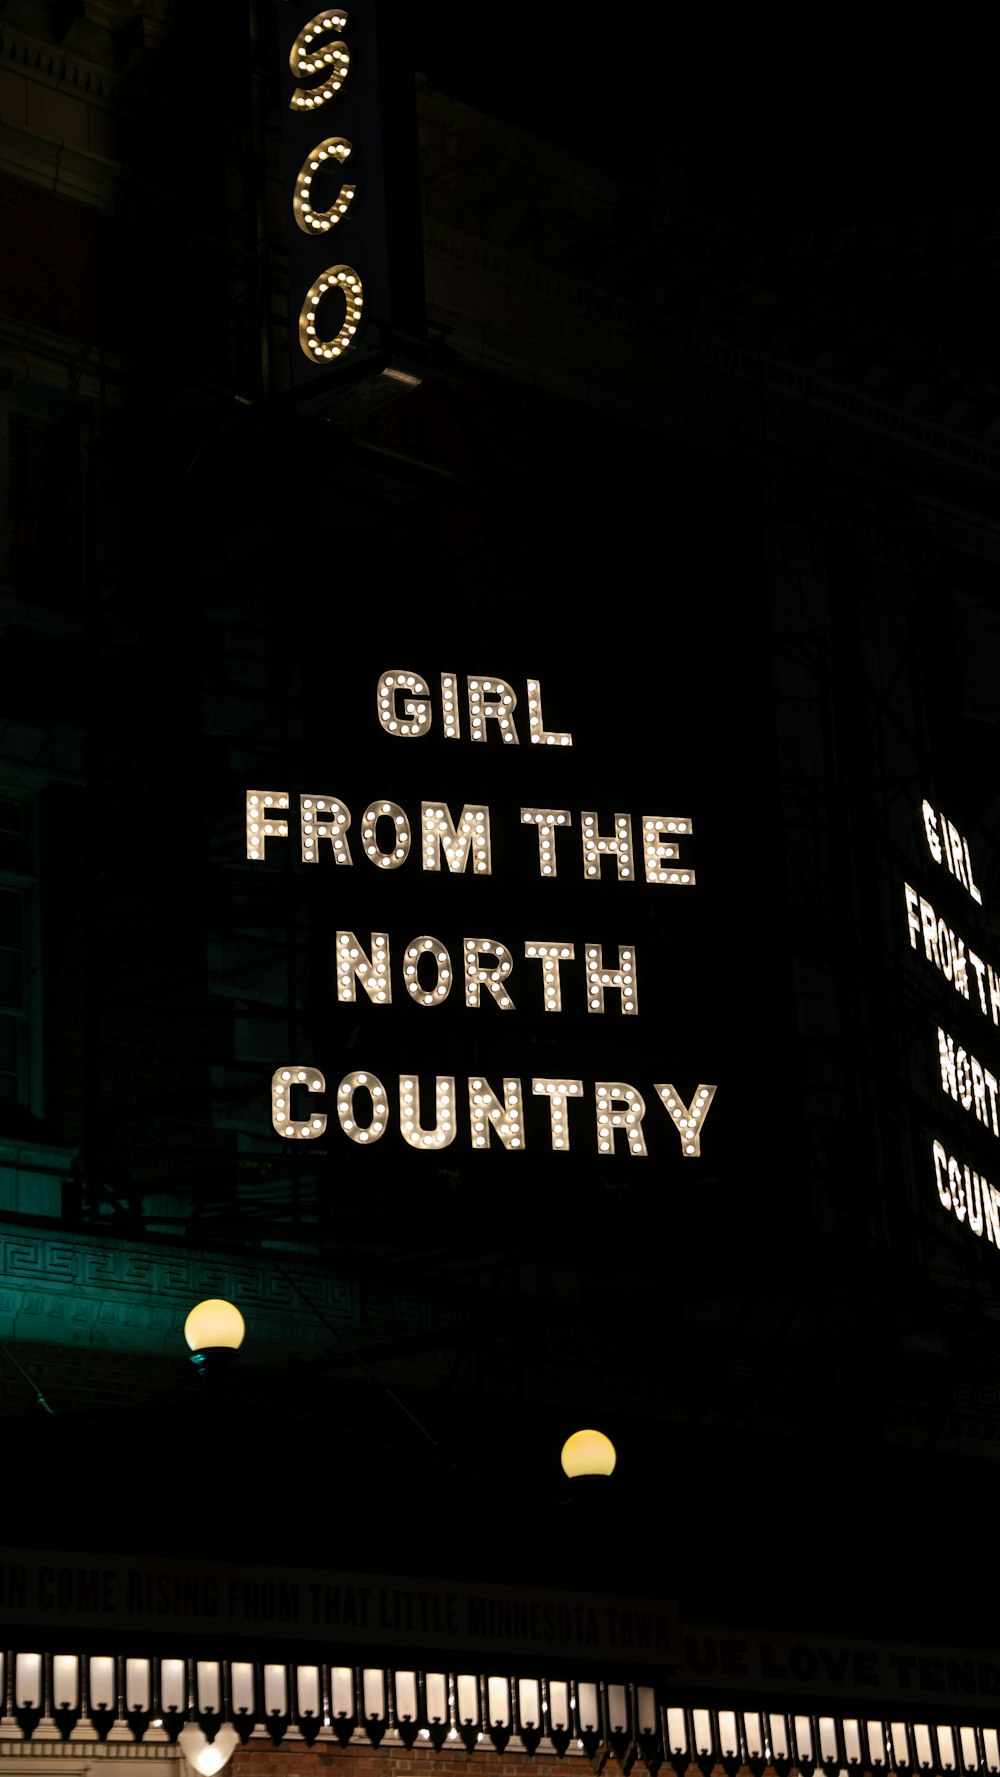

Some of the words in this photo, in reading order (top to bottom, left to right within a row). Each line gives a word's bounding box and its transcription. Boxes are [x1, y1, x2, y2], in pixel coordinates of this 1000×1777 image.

[377, 670, 573, 746] GIRL
[246, 790, 492, 875] FROM
[521, 807, 696, 885] THE
[922, 799, 982, 905] GIRL
[336, 931, 639, 1015] NORTH
[904, 882, 970, 1000] FROM
[272, 1066, 718, 1158] COUNTRY
[38, 1567, 116, 1613] COME
[127, 1571, 219, 1617] RISING
[229, 1578, 300, 1623] FROM
[309, 1584, 371, 1627] THAT
[380, 1589, 459, 1633] LITTLE
[467, 1597, 599, 1645] MINNESOTA
[606, 1608, 670, 1650] TOWN
[760, 1642, 880, 1687] LOVE
